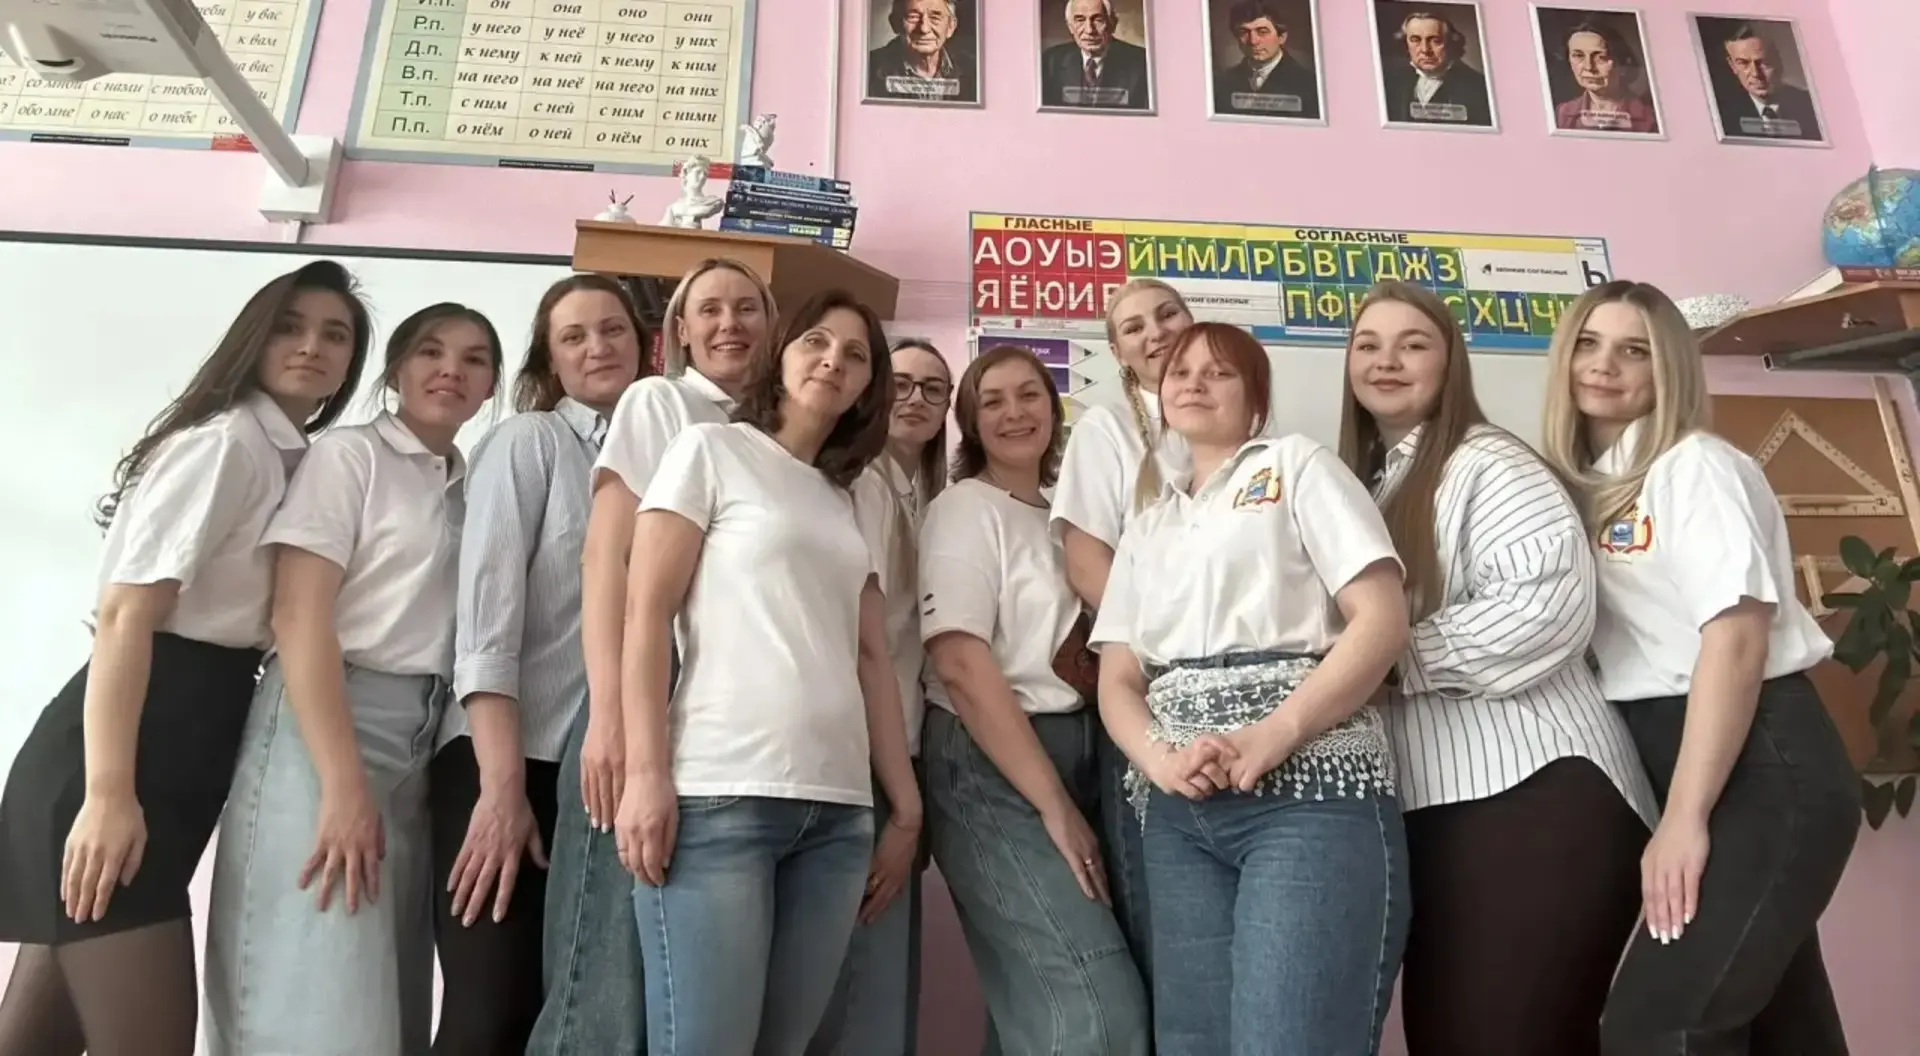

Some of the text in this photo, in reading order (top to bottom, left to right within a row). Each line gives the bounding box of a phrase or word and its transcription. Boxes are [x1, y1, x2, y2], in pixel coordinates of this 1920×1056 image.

[490, 0, 511, 10] он
[553, 3, 582, 14] она
[244, 8, 283, 23] у вас
[618, 8, 647, 19] оно
[684, 12, 713, 23] они
[413, 16, 445, 31] Р.п.
[470, 22, 521, 36] у него
[237, 33, 278, 46] к вам
[544, 26, 585, 40] у неё
[606, 32, 655, 44] у него
[404, 40, 442, 58] Д.п.
[675, 36, 718, 50] у них
[464, 47, 520, 63] к нему
[539, 51, 582, 64] к ней
[249, 60, 275, 72] вас
[600, 56, 655, 72] к нему
[671, 60, 717, 72] к ним
[402, 66, 438, 81] В.п.
[457, 71, 520, 85] на него
[92, 82, 144, 94] с нами
[151, 85, 160, 94] с
[532, 76, 585, 90] на неё
[594, 80, 655, 94] на него
[665, 84, 720, 98] на них
[400, 91, 432, 107] Т.п.
[461, 98, 508, 110] с ним
[18, 103, 42, 116] обо
[44, 108, 76, 118] мне
[91, 108, 130, 121] о нас
[533, 102, 575, 114] с ней
[600, 106, 645, 119] с ним
[148, 110, 198, 124] о тебе
[662, 110, 718, 123] с ними
[392, 117, 430, 134] П.п.
[456, 123, 504, 136] о нём
[528, 127, 573, 140] о ней
[596, 132, 642, 144] о нём
[666, 136, 710, 148] о них
[1004, 217, 1092, 232] ГЛАСНЫЕ
[1295, 229, 1409, 244] СОГЛАСНЫЕ
